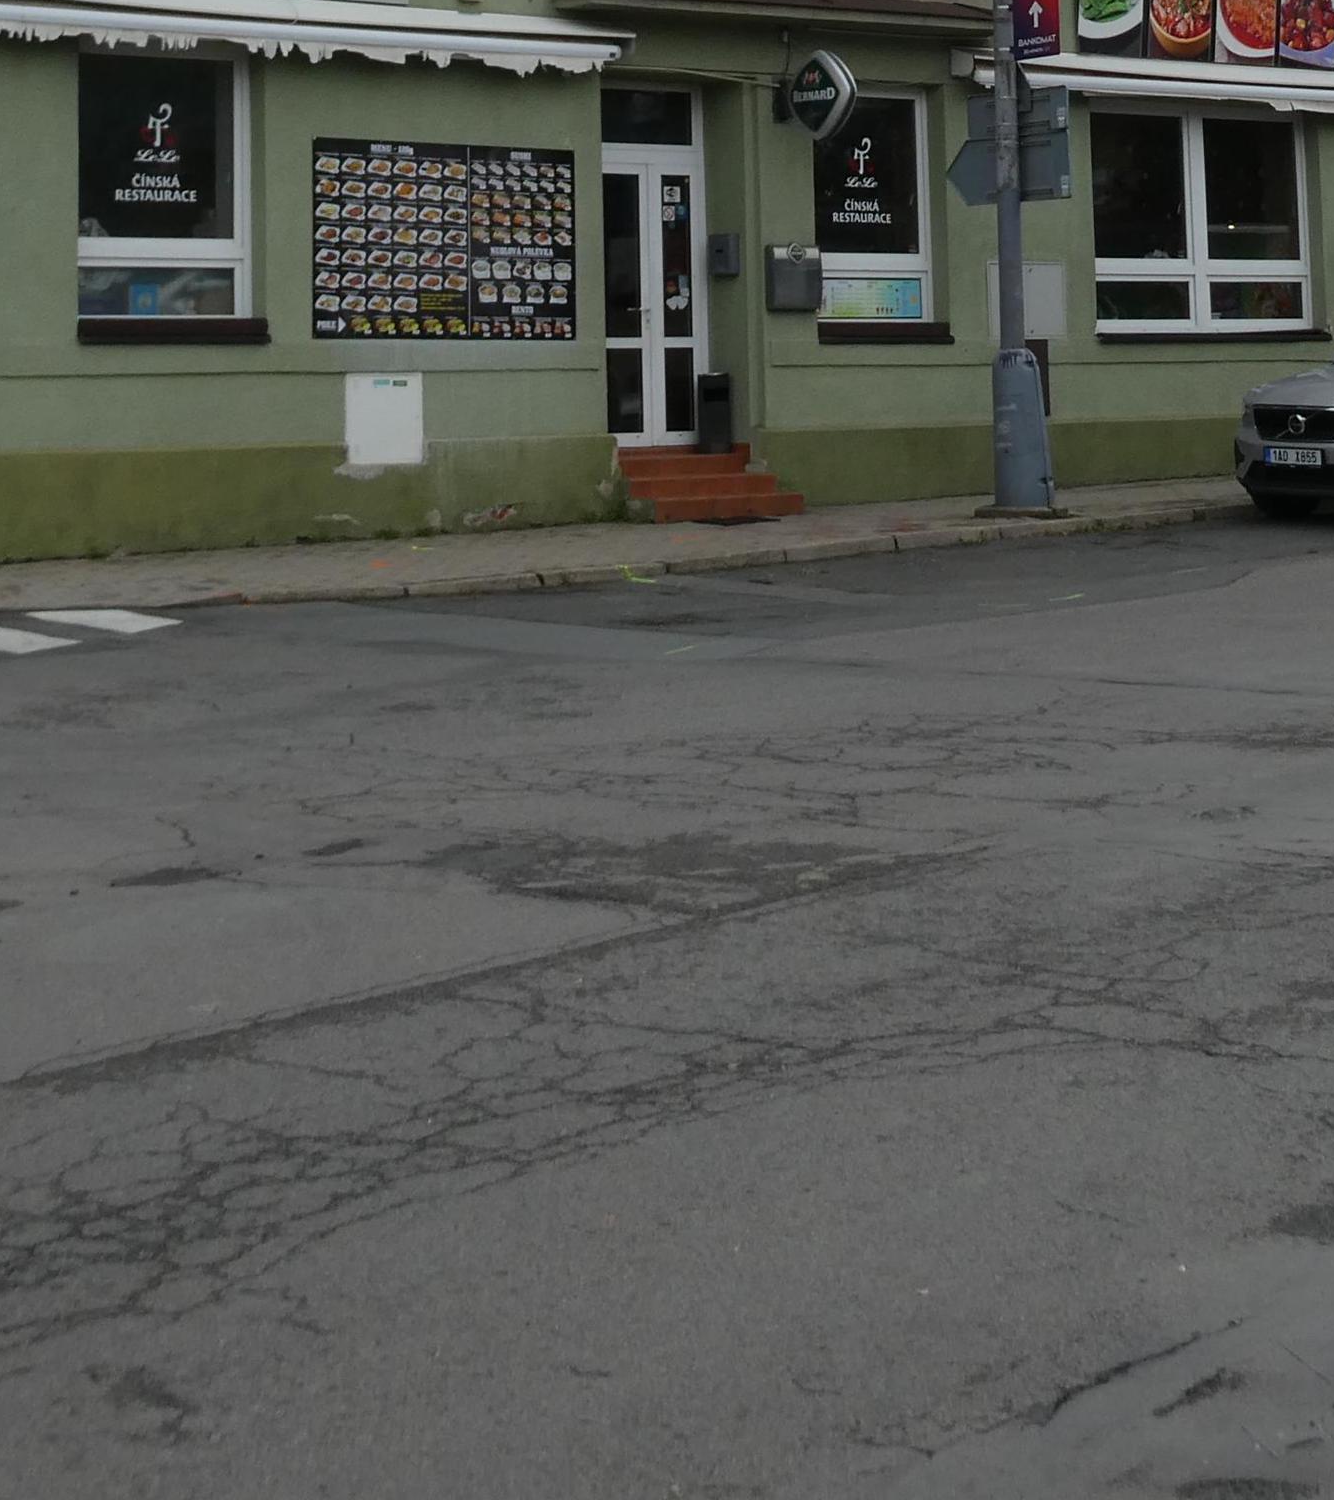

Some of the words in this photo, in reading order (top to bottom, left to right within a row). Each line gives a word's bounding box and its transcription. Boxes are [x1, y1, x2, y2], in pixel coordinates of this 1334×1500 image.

[1018, 33, 1057, 48] BANKOMAT
[793, 86, 836, 103] BERNARD
[131, 172, 181, 189] ČÍNSKÁ
[114, 188, 198, 203] RESTAURACE
[844, 198, 880, 212] ČÍNSKÁ
[832, 212, 892, 224] RESTAURACE
